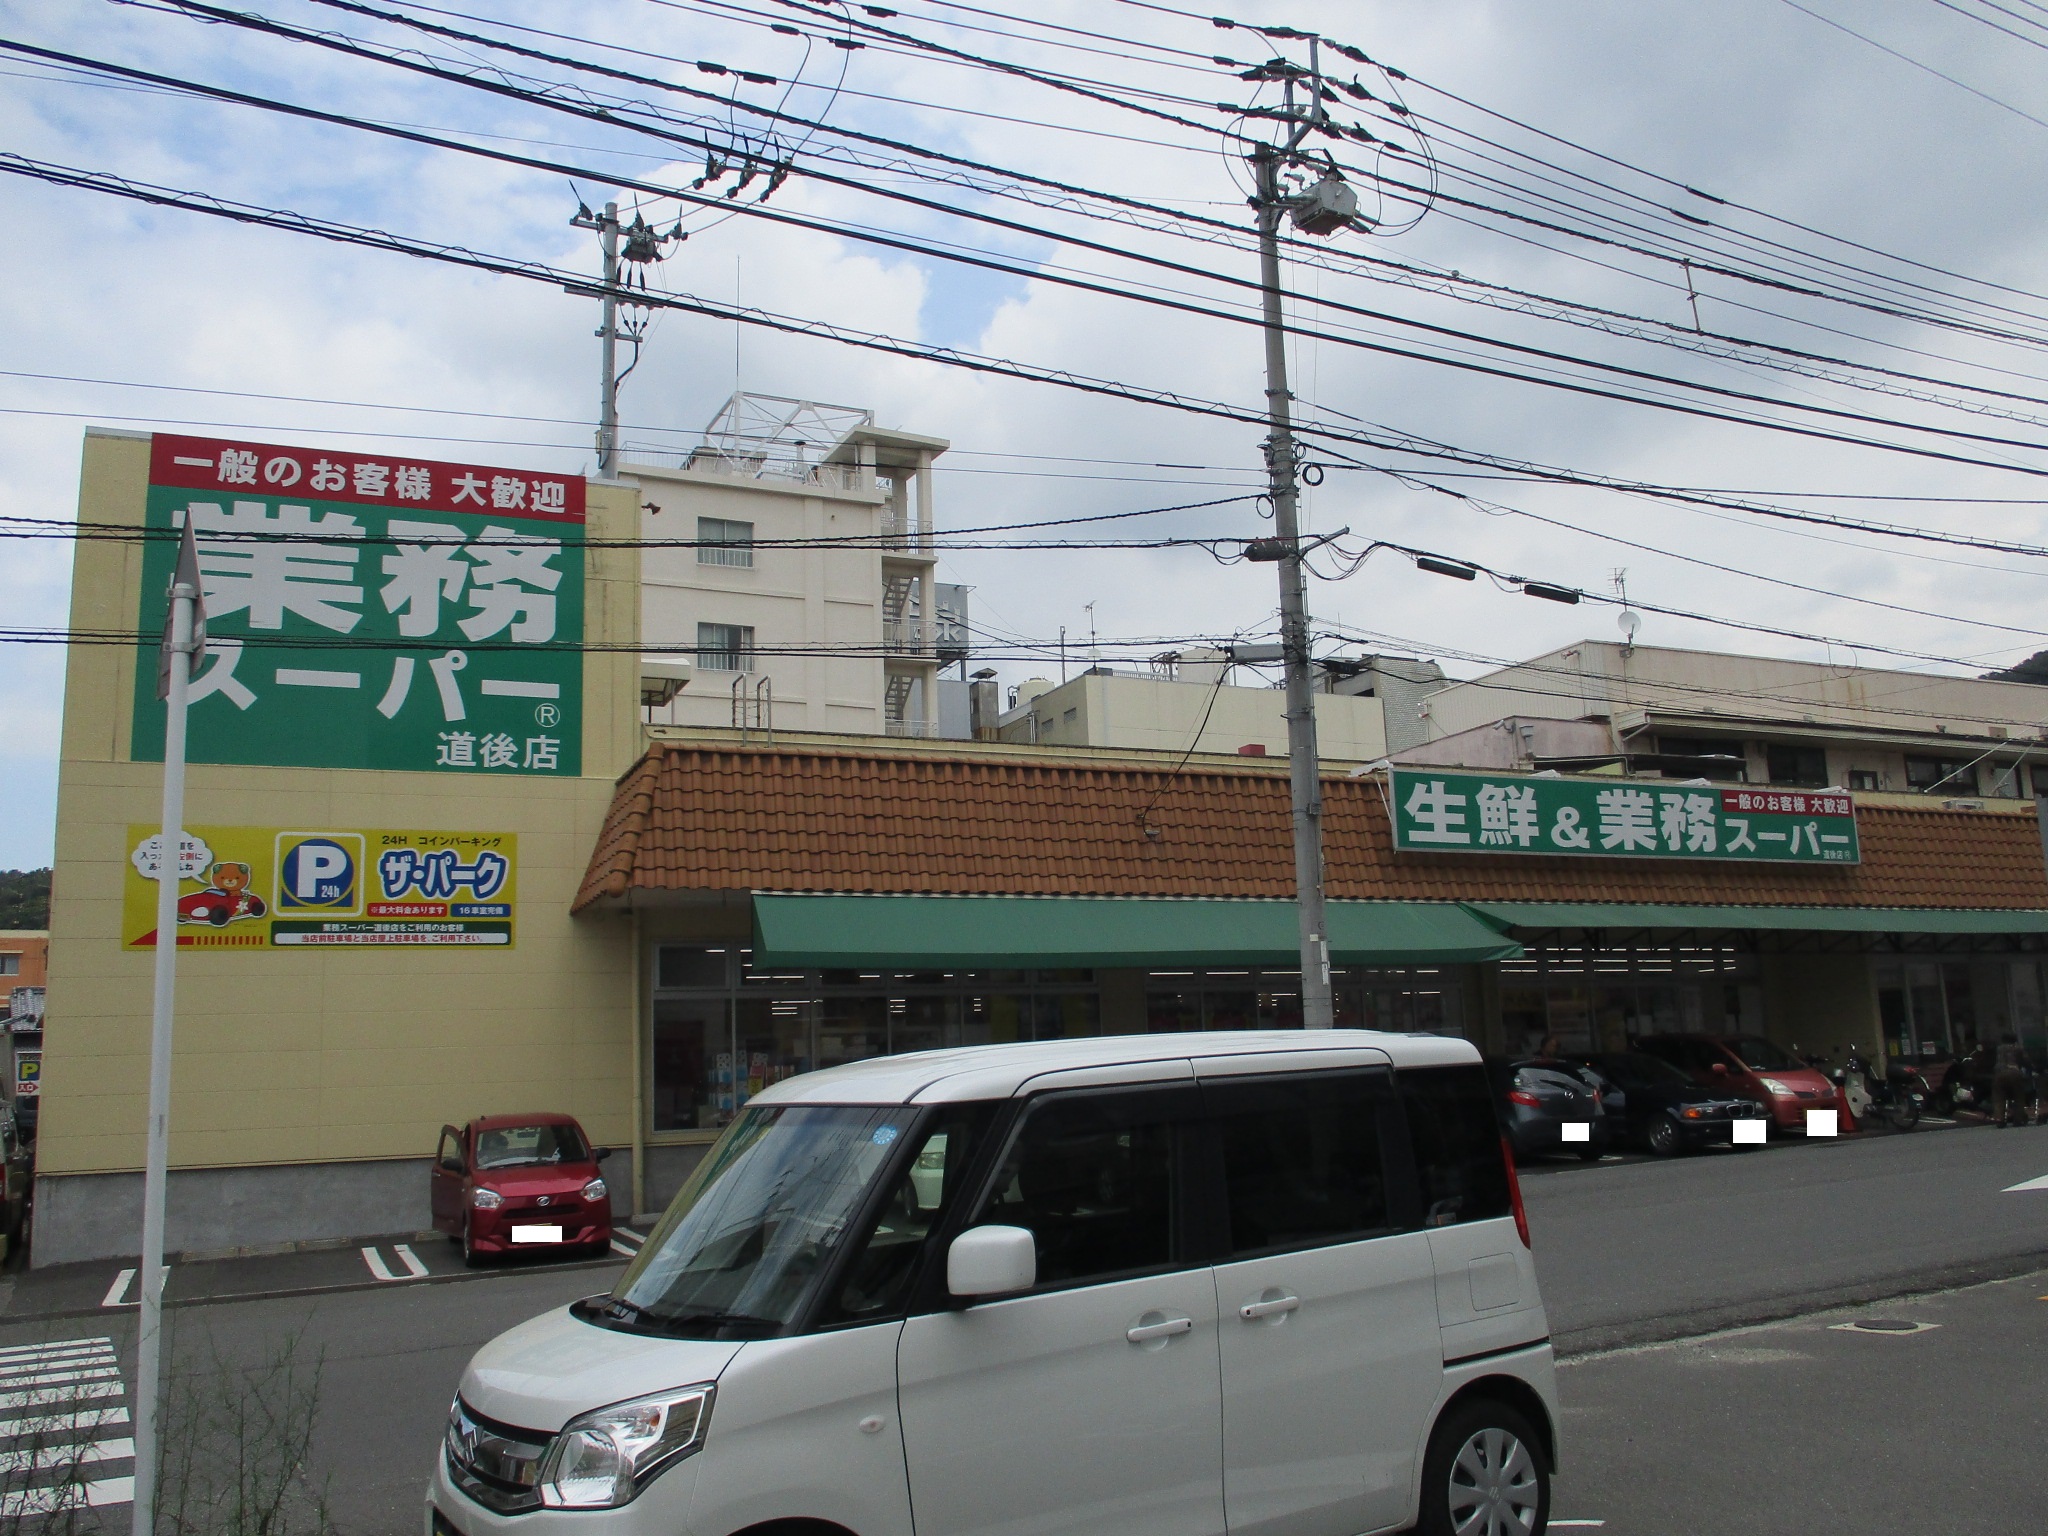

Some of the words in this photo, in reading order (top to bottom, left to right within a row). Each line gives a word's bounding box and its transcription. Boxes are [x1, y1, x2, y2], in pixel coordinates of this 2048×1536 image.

[173, 448, 431, 501] 一般のお客様
[451, 472, 566, 515] 大歓迎
[170, 500, 562, 644] 業務
[176, 636, 560, 722] スーパー
[436, 731, 560, 770] 道後店
[1725, 794, 1806, 813] 一般のお客様
[1811, 798, 1850, 814] 大歓迎
[382, 835, 407, 845] 24H
[298, 846, 347, 897] P
[321, 885, 340, 898] 24h
[21, 1063, 39, 1079] P
